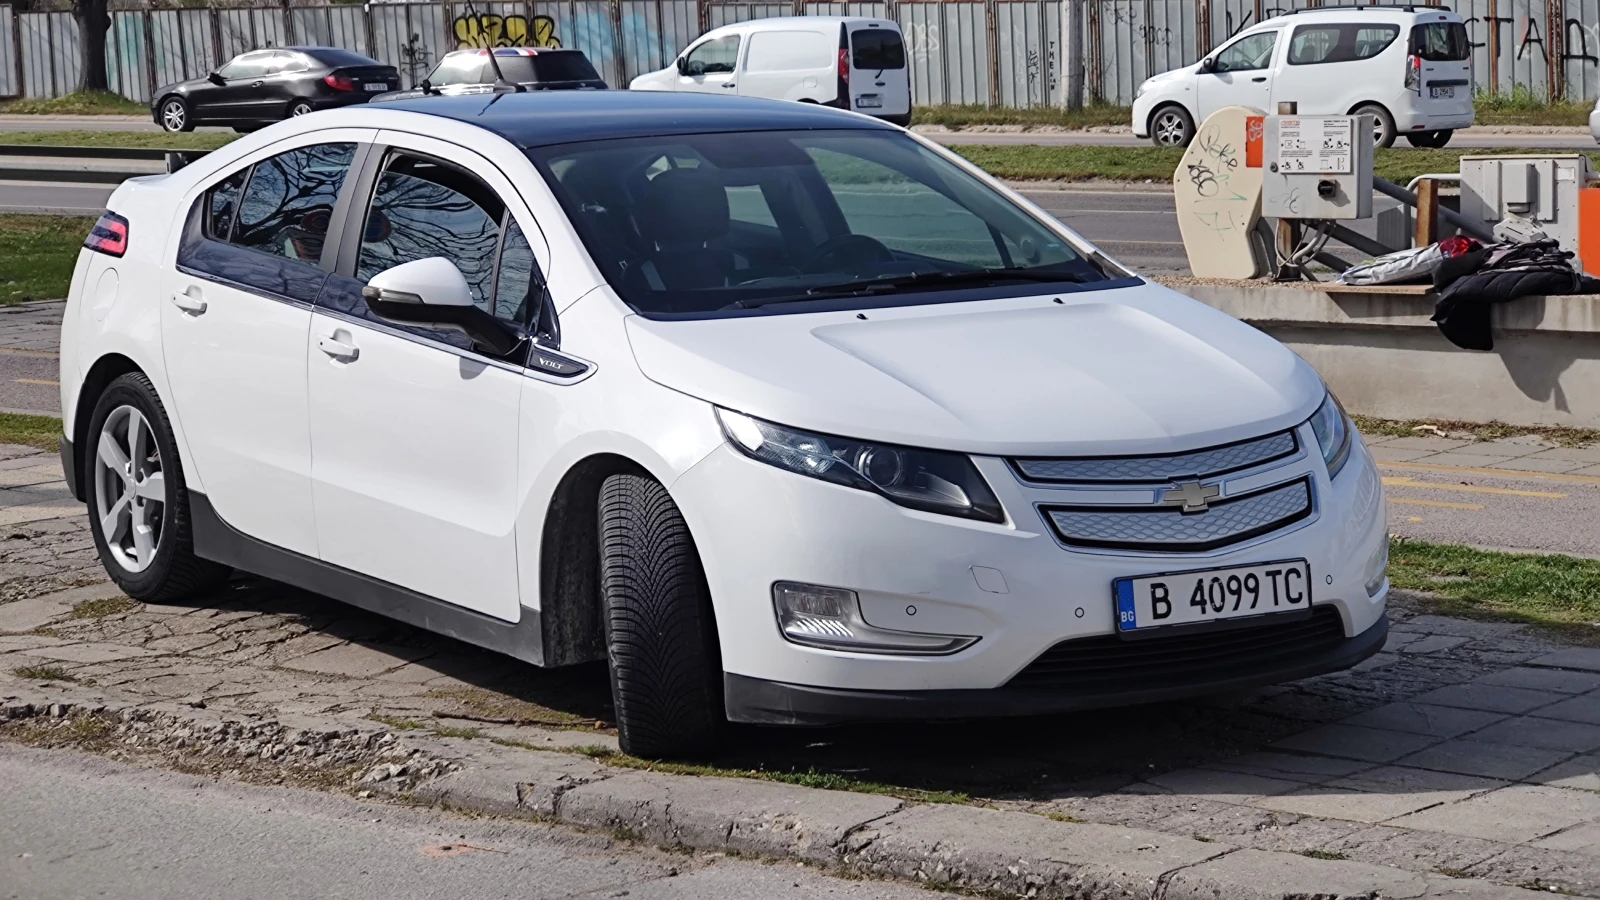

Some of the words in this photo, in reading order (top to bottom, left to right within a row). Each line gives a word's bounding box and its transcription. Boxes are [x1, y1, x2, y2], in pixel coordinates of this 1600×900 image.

[539, 357, 564, 370] VOLT
[1150, 583, 1172, 620] B
[1189, 573, 1260, 615] 4099
[1265, 567, 1303, 606] TC
[1120, 610, 1135, 623] BG
